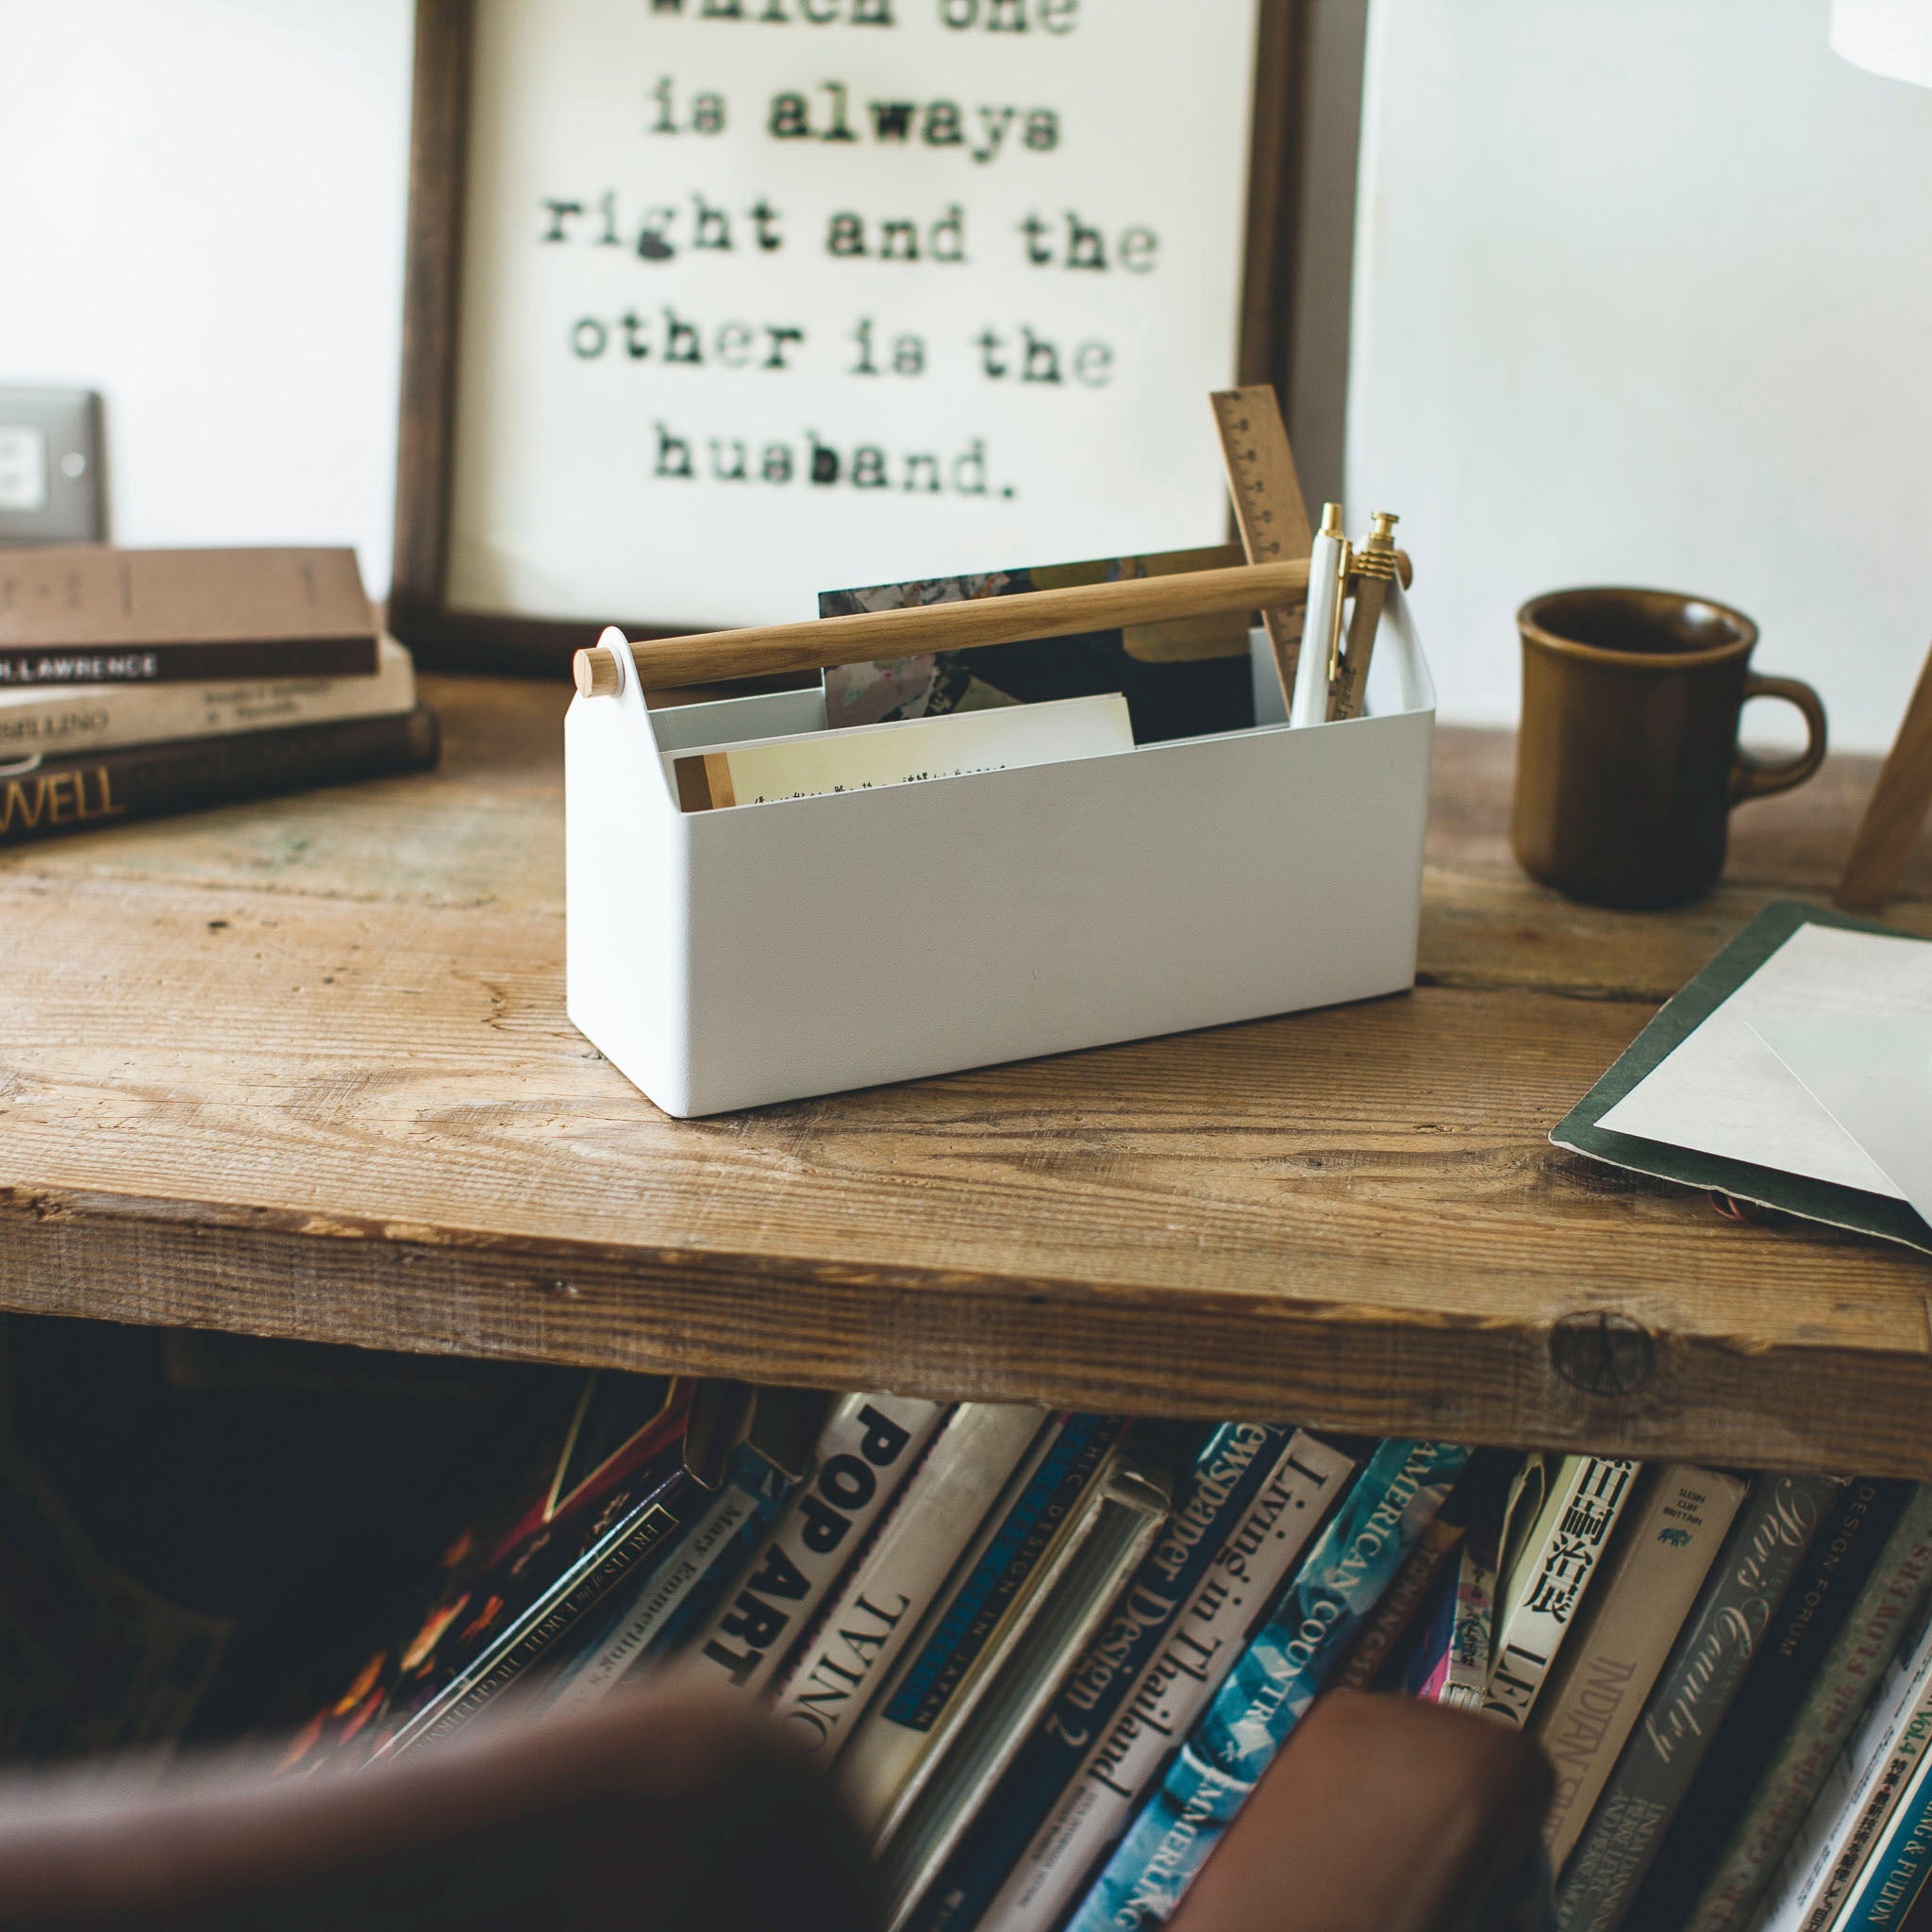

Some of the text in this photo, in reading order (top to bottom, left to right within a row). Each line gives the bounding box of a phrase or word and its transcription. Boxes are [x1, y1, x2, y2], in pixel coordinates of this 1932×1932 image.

[647, 77, 1060, 162] is always
[542, 192, 1159, 273] right and the
[572, 310, 1114, 386] other is the
[653, 423, 1016, 498] husband.
[702, 1404, 912, 1687] POP ART
[913, 1409, 1123, 1726] APHIC DESIGN IN JAPAN
[1326, 1437, 1442, 1598] AMERICAN
[1776, 1482, 1876, 1658] DESIGN FORUM
[584, 1502, 742, 1689] Mary Emmerling's
[1069, 1581, 1176, 1713] Design
[1087, 1452, 1329, 1800] Living in Thailand
[1644, 1477, 1821, 1763] Paris Country
[1844, 1538, 1932, 1680] FLOWERS
[785, 1591, 912, 1753] ONIAL
[1043, 1710, 1090, 1749] 2
[1555, 1653, 1637, 1775] INDIAN
[1898, 1711, 1932, 1755] Vol.4
[1867, 1858, 1917, 1925] FULTON
[1904, 1840, 1927, 1855] &
